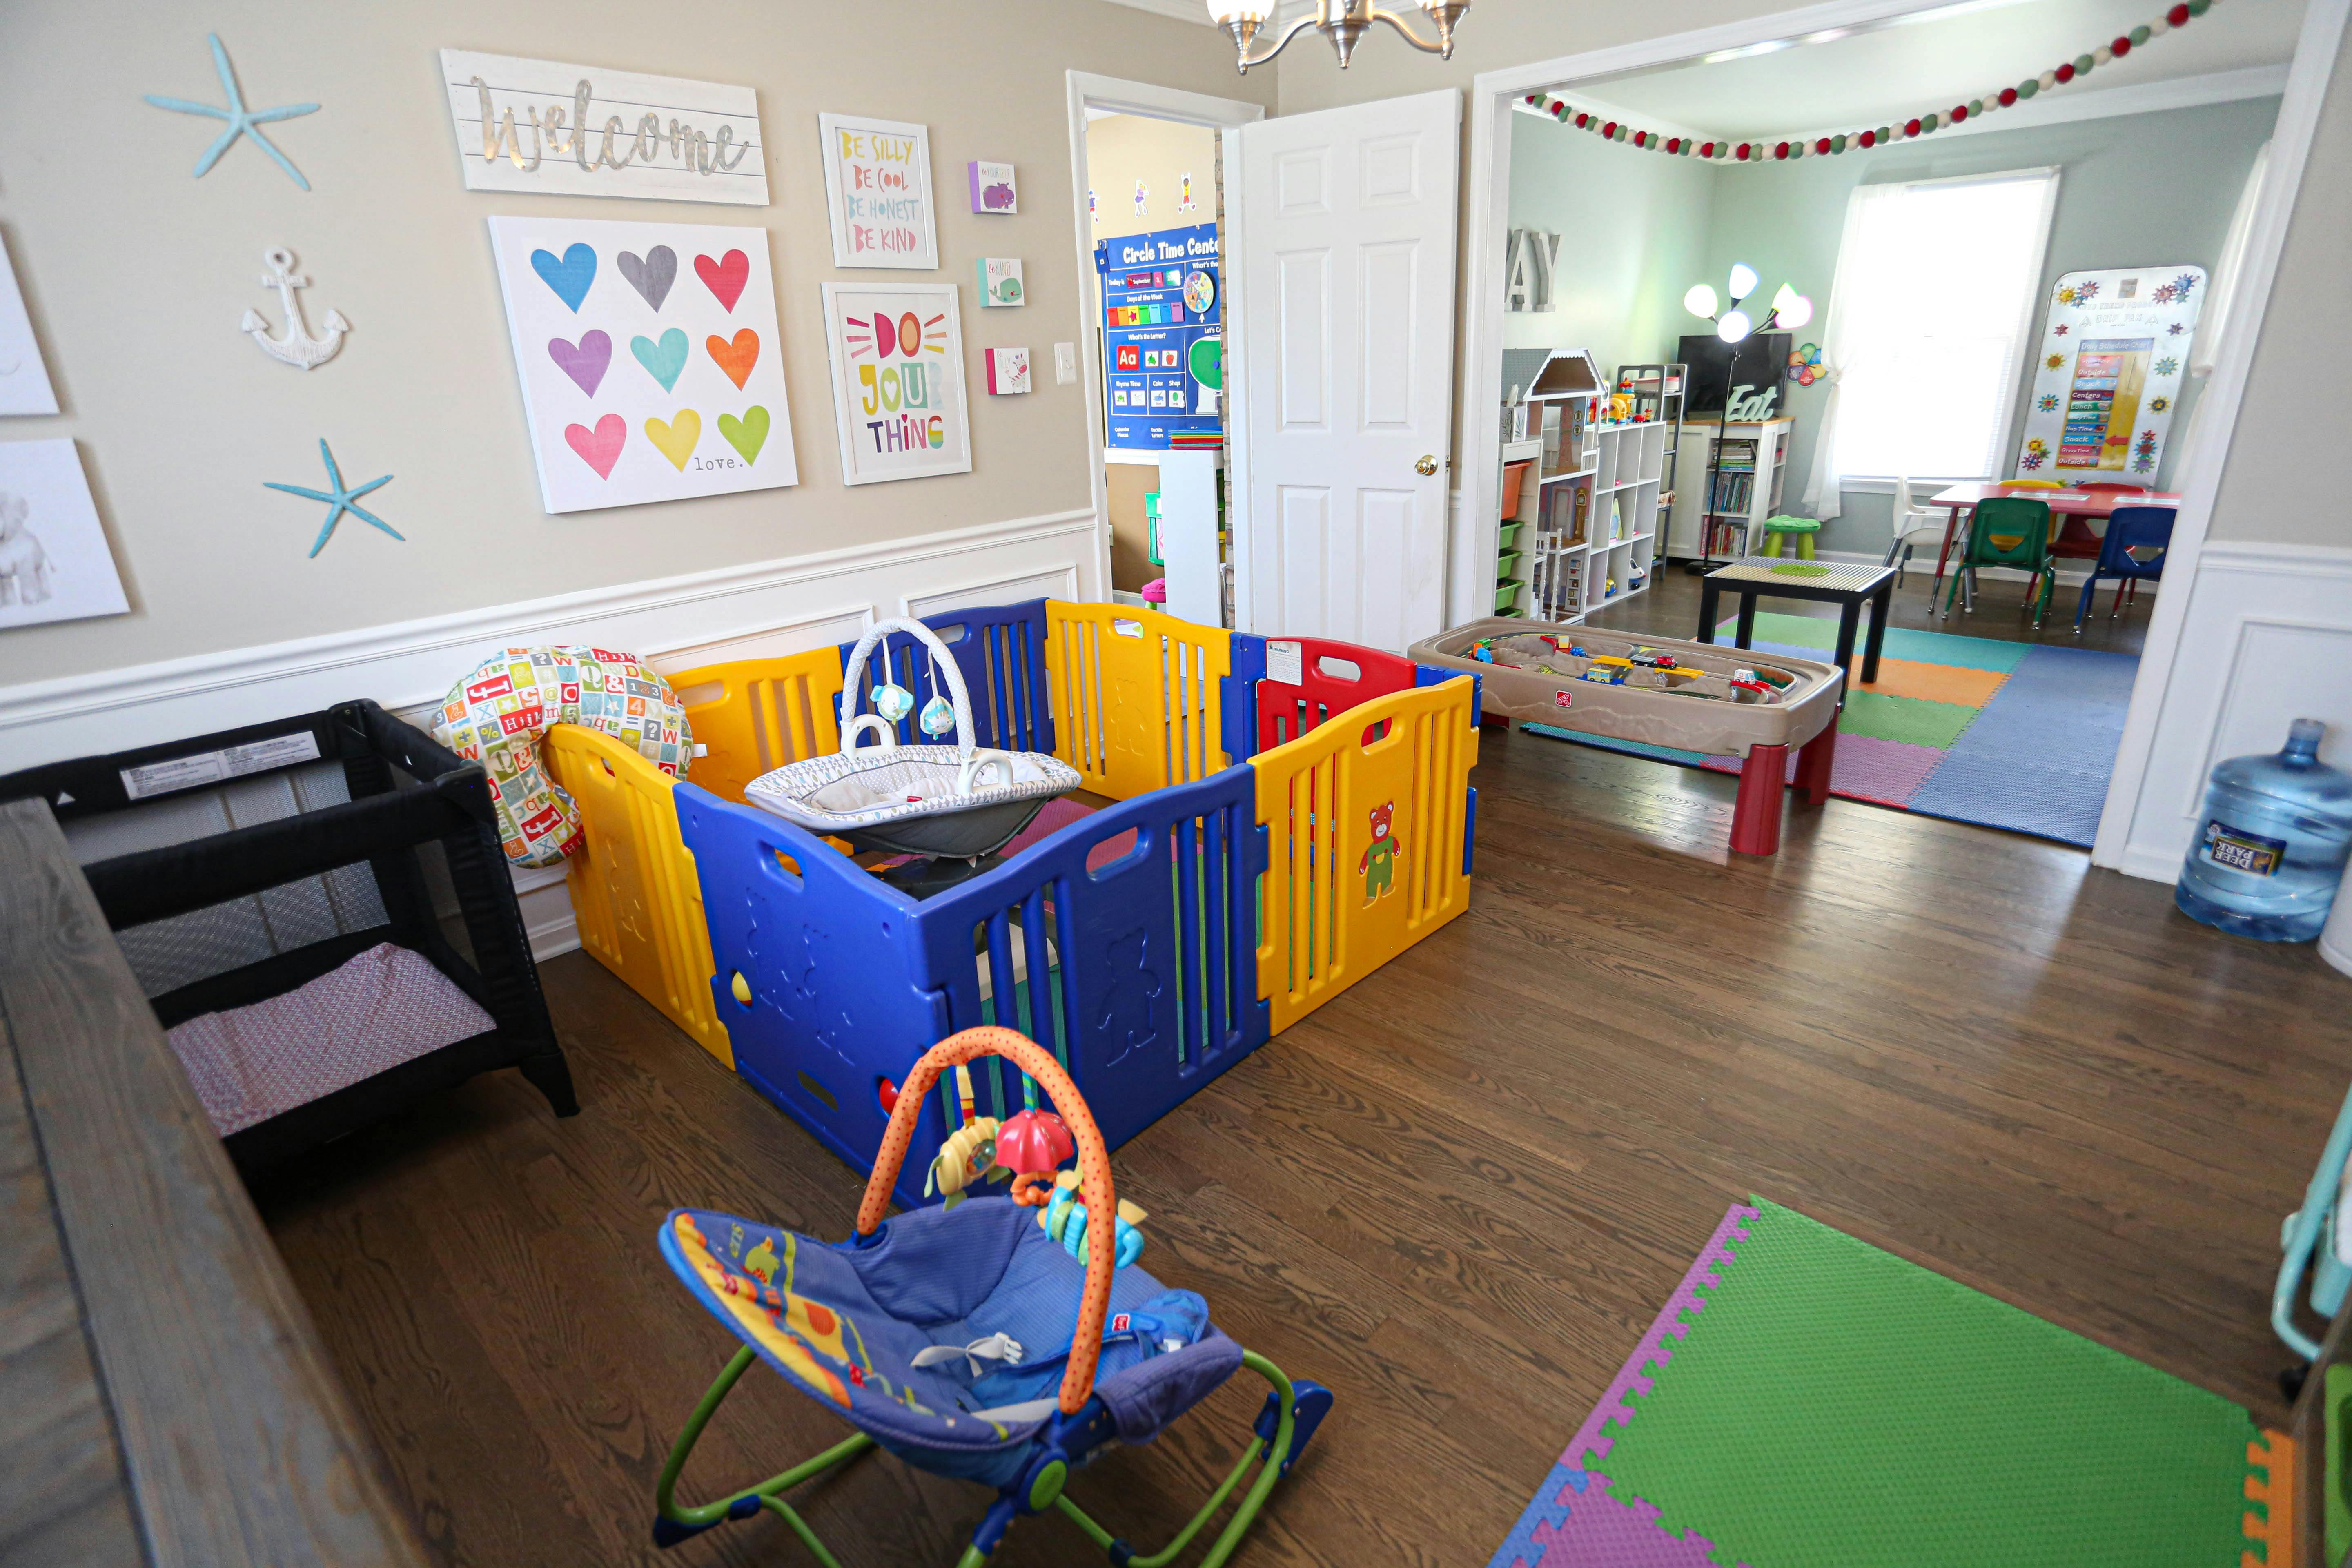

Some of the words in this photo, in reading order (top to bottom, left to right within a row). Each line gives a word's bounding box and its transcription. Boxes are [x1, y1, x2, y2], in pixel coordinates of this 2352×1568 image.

[841, 131, 864, 160] BE
[872, 135, 913, 165] SILLY
[853, 165, 872, 191] BE
[878, 169, 909, 192] COOL
[846, 194, 864, 220] BE
[870, 199, 918, 221] HONEST
[853, 224, 874, 253] BE
[882, 227, 917, 254] KIND
[1123, 242, 1155, 263] Circle
[1157, 241, 1184, 260] Time
[996, 261, 1011, 276] KIND
[874, 312, 921, 358] DO
[2082, 343, 2098, 351] Daily
[2099, 341, 2129, 349] Schedule
[1119, 350, 1136, 365] Aa
[1725, 385, 1777, 421] Eat
[695, 457, 743, 470] love.
[1557, 693, 1569, 704] STEP
[662, 729, 677, 744] W
[2215, 849, 2249, 869] DEER
[2216, 841, 2253, 859] PARK
